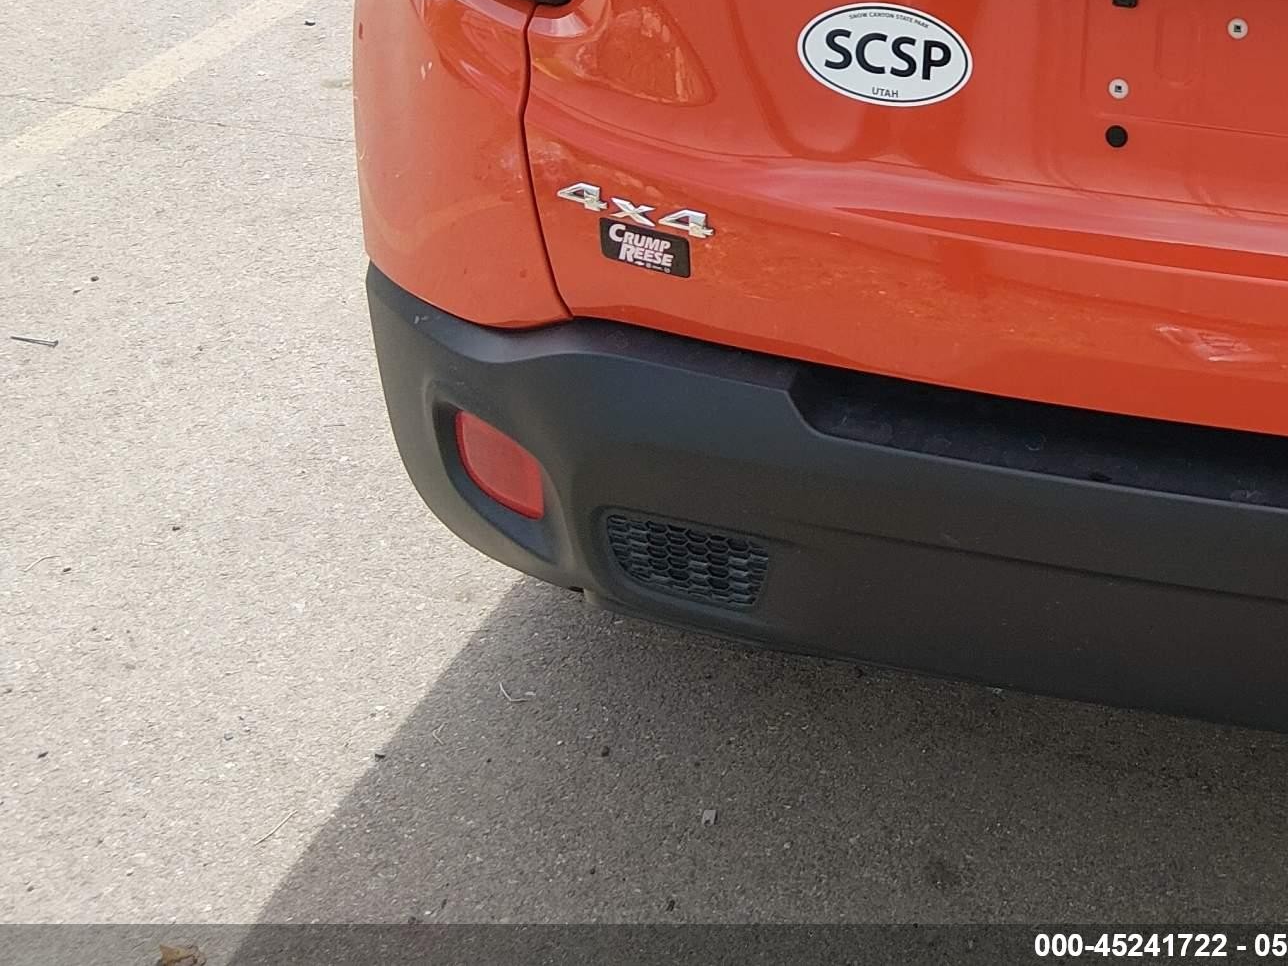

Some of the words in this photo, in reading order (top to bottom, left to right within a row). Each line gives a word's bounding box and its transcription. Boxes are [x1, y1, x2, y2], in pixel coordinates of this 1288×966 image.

[824, 28, 952, 81] SCSP
[871, 86, 899, 99] UTAH
[608, 223, 671, 252] CRUMP
[618, 242, 674, 267] REESE
